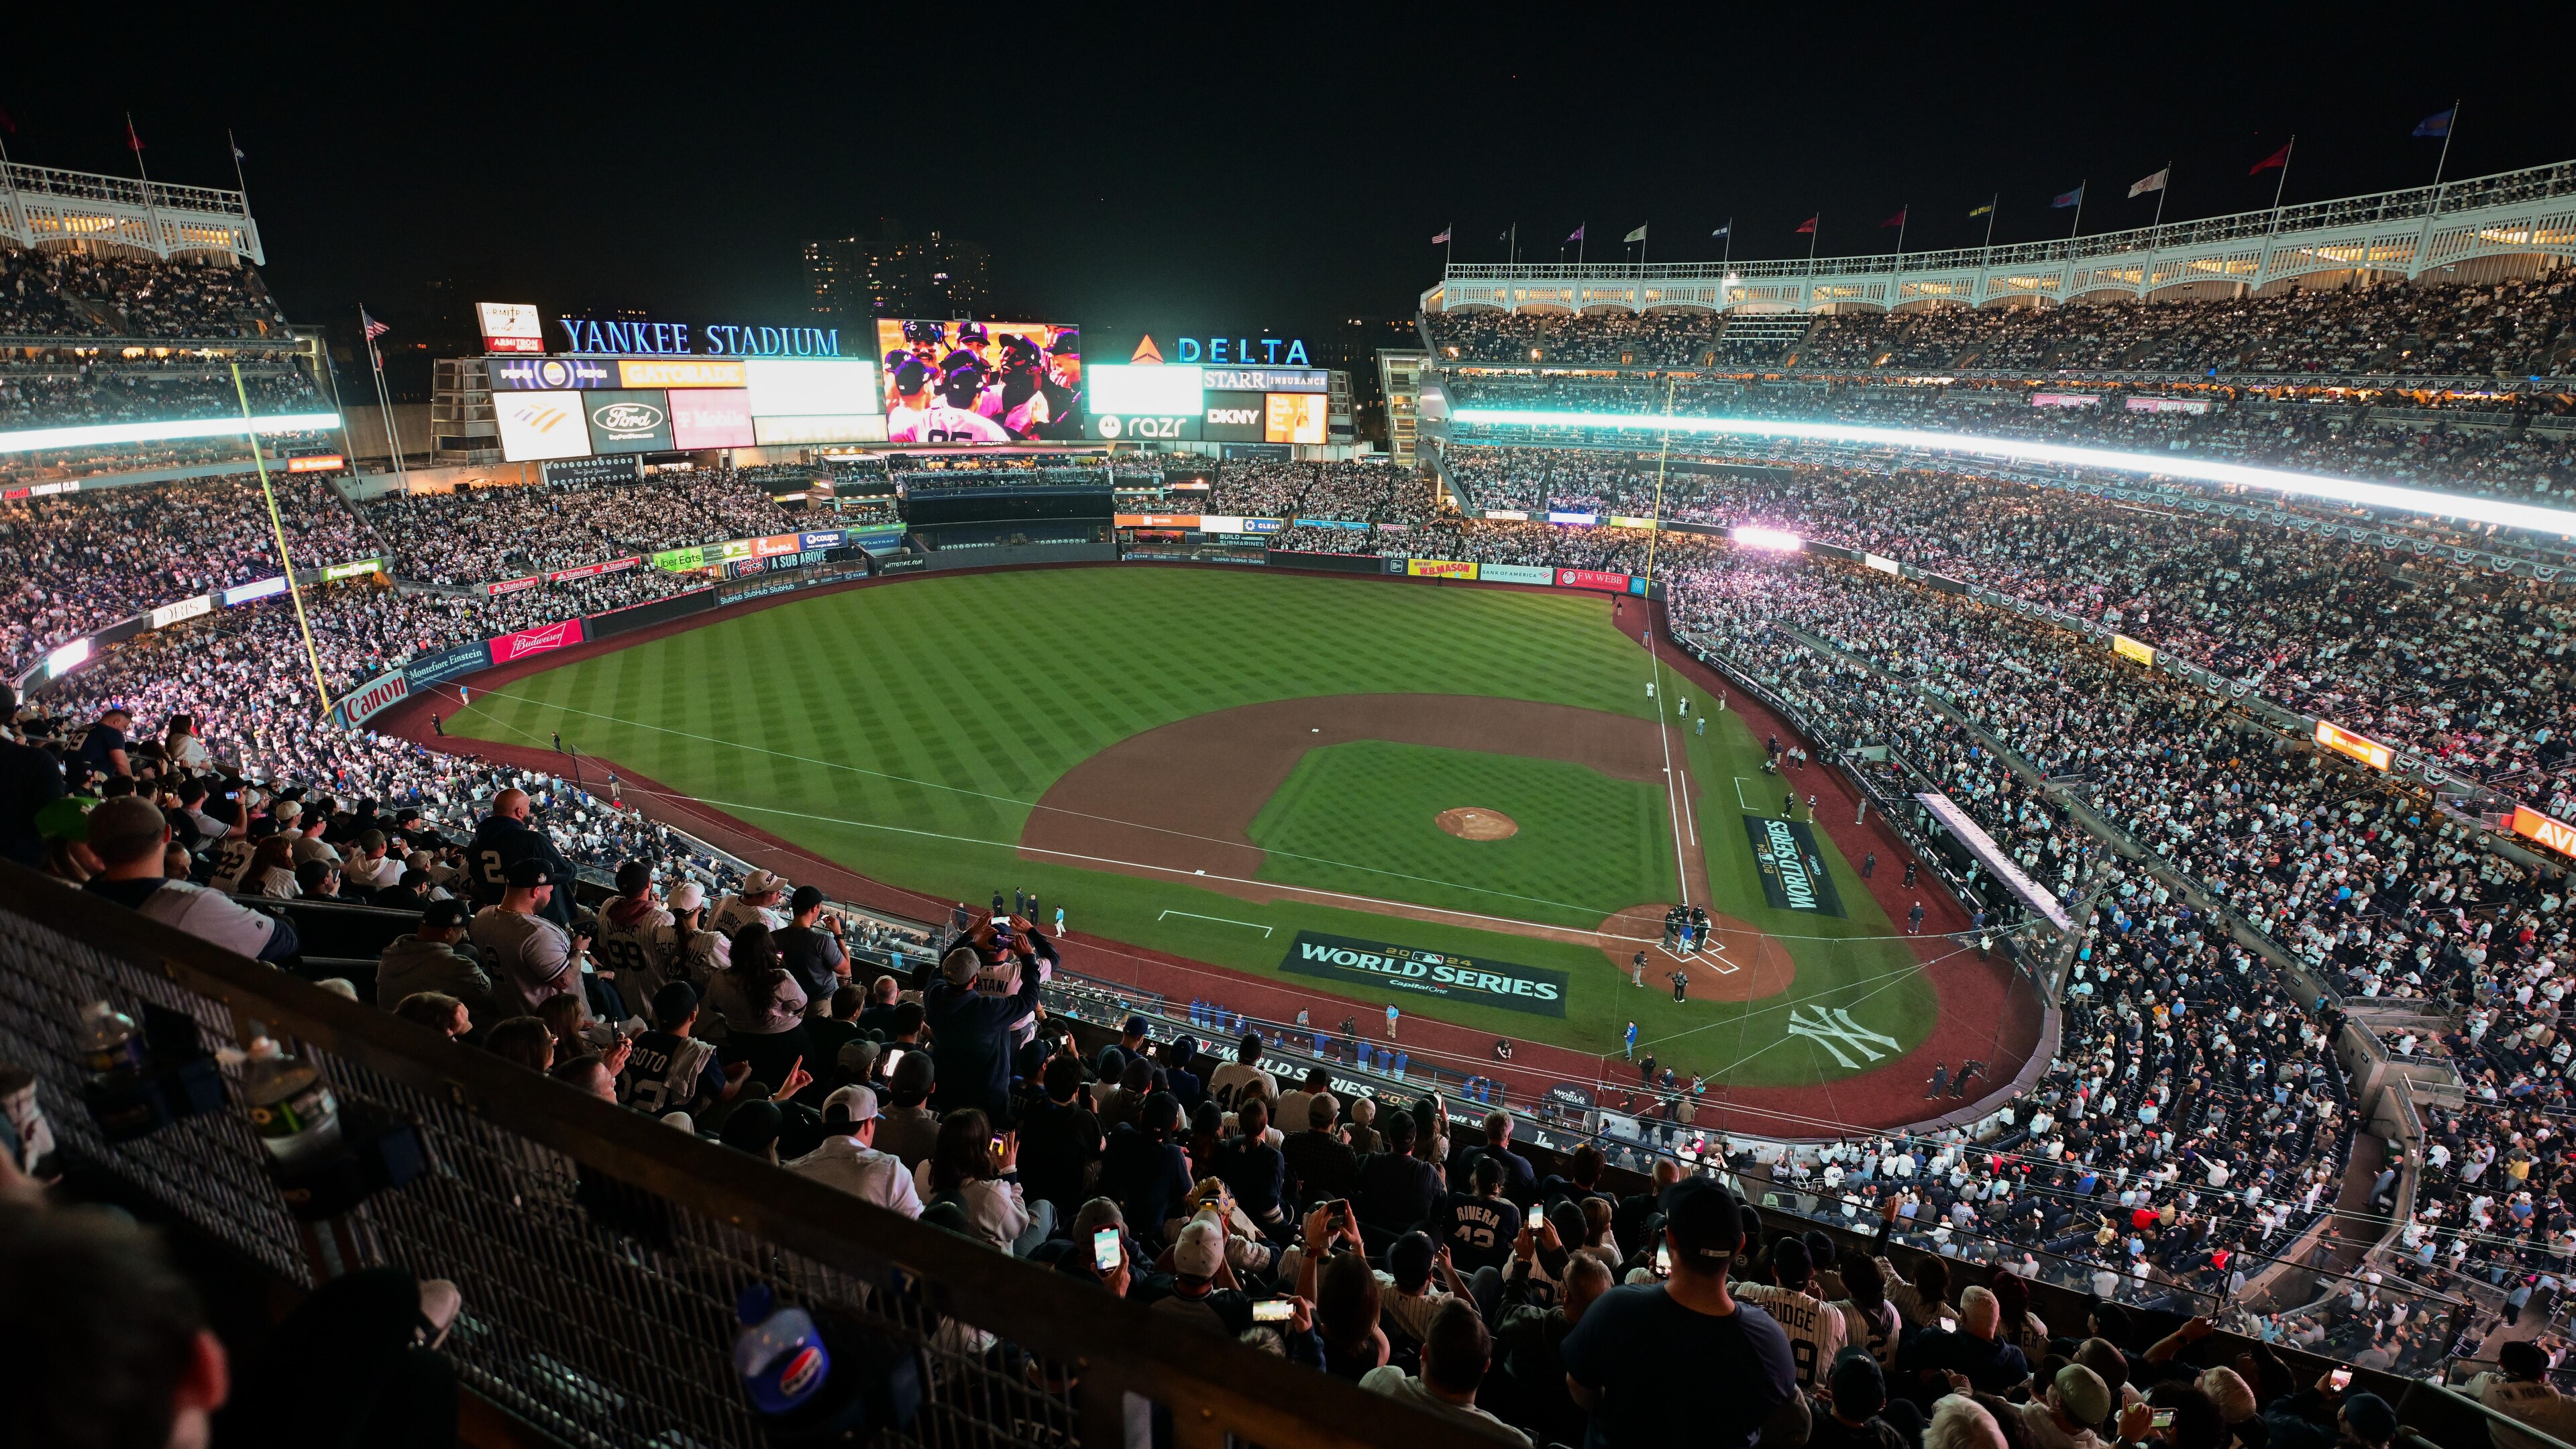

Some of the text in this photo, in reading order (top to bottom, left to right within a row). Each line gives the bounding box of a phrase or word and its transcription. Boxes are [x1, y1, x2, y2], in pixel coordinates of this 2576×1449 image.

[494, 338, 539, 347] ARMITRON
[560, 319, 840, 356] YANKEE STADIUM
[1178, 337, 1309, 365] DELTA
[628, 364, 741, 383] GATORADE
[1204, 371, 1326, 388] STARR INSURANCE
[2057, 396, 2077, 406] PARTY
[2157, 401, 2181, 411] PARTY
[2183, 402, 2206, 415] DECK
[606, 407, 651, 427] Ford
[695, 409, 746, 427] Mobile
[1207, 409, 1260, 424] DKNY
[1128, 417, 1186, 437] razr
[583, 469, 593, 477] York
[594, 467, 611, 476] Yankees
[3, 486, 30, 499] Audi
[815, 534, 839, 543] coupa
[655, 558, 677, 569] Uber
[679, 554, 702, 564] Eats
[737, 557, 763, 569] Jersey
[772, 549, 827, 570] A SUB ABOVE
[1577, 572, 1593, 581] F.W.
[1596, 574, 1623, 584] WEBB
[720, 593, 743, 605] StubHub
[744, 588, 768, 599] StubHub
[769, 583, 794, 594] StubHub
[163, 600, 199, 622] ORIS
[513, 632, 563, 652] Budweiser
[409, 649, 483, 680] Montefiore Einstein
[346, 676, 407, 723] Canon
[1764, 820, 1799, 861] SERIES
[480, 849, 505, 884] 2
[1778, 859, 1817, 908] WORLD
[606, 938, 646, 972] 99
[1385, 947, 1472, 967] 20 24
[1301, 943, 1559, 1000] WORLD SERIES
[1788, 1004, 1902, 1069] NY
[629, 1046, 668, 1073] SOTO
[1218, 1044, 1378, 1099] WOLD SRIES
[1553, 1088, 1586, 1102] WORLD
[1456, 1205, 1501, 1230] RIVERA
[2520, 1387, 2550, 1400] YORK
